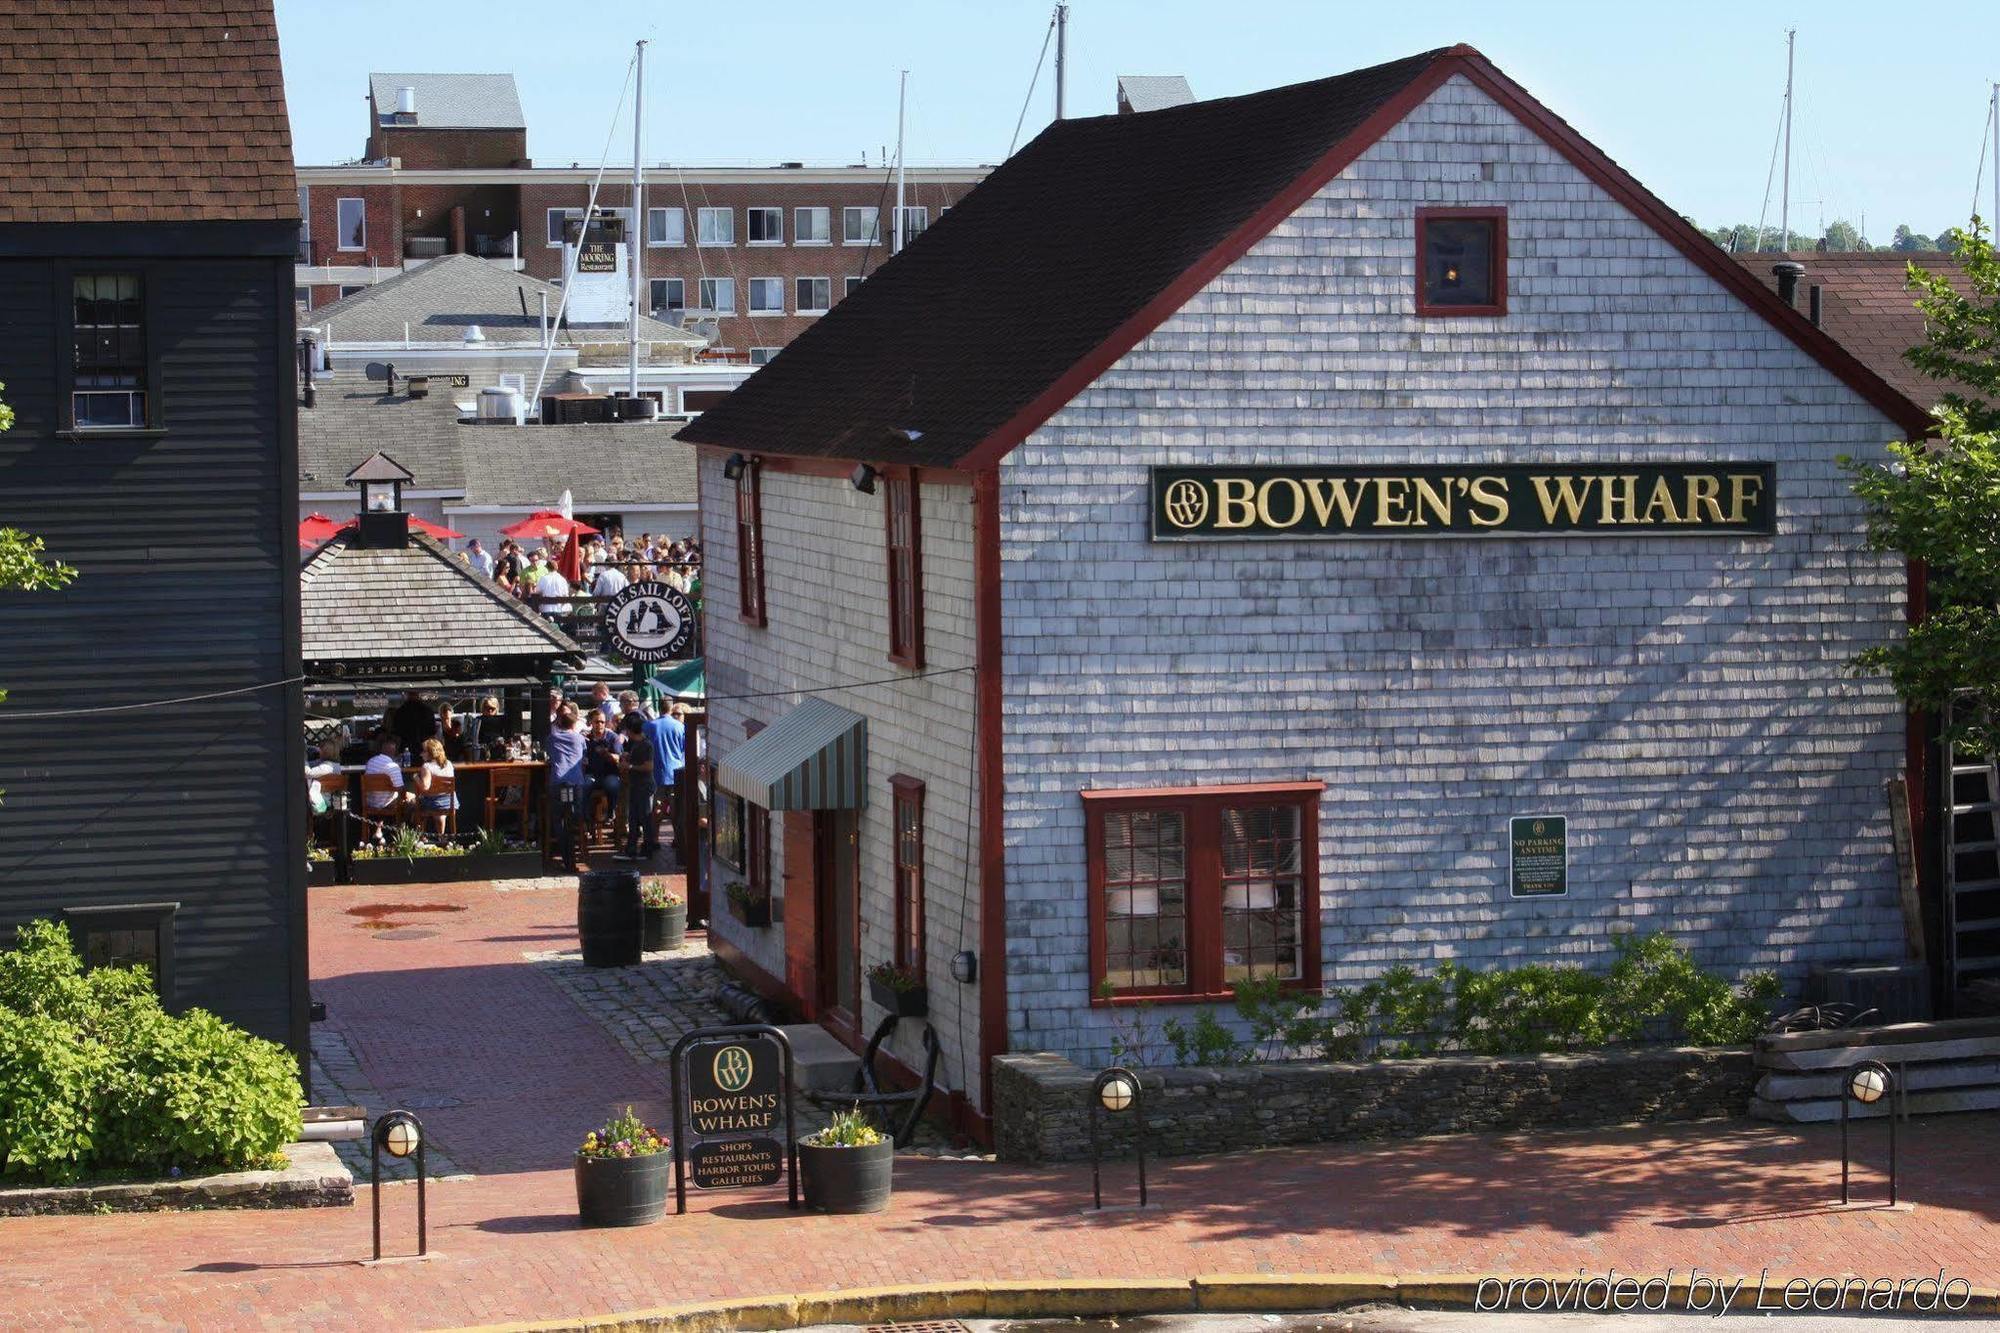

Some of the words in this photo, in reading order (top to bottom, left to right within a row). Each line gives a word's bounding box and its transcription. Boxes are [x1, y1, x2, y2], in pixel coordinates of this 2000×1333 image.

[590, 244, 605, 252] THE
[580, 253, 615, 262] MOORING
[1213, 476, 1509, 526] BOWEN'S
[1529, 474, 1764, 525] WHARF
[605, 592, 628, 626] THE
[628, 583, 661, 598] SAIL
[664, 587, 693, 625] LOFT
[611, 635, 669, 661] CLOTHING
[670, 635, 688, 652] CO.
[358, 666, 374, 674] 22
[381, 664, 447, 673] PORTSIDE
[1513, 839, 1526, 848] NO
[1527, 837, 1564, 847] PARKING
[693, 1094, 777, 1113] BOWEN'S
[699, 1113, 772, 1131] WHARF
[720, 1142, 752, 1152] SHOPS
[702, 1152, 771, 1164] RESTAURANTS
[698, 1165, 740, 1176] HARBOR
[743, 1163, 776, 1172] TOURS
[711, 1174, 763, 1185] GALLERIES
